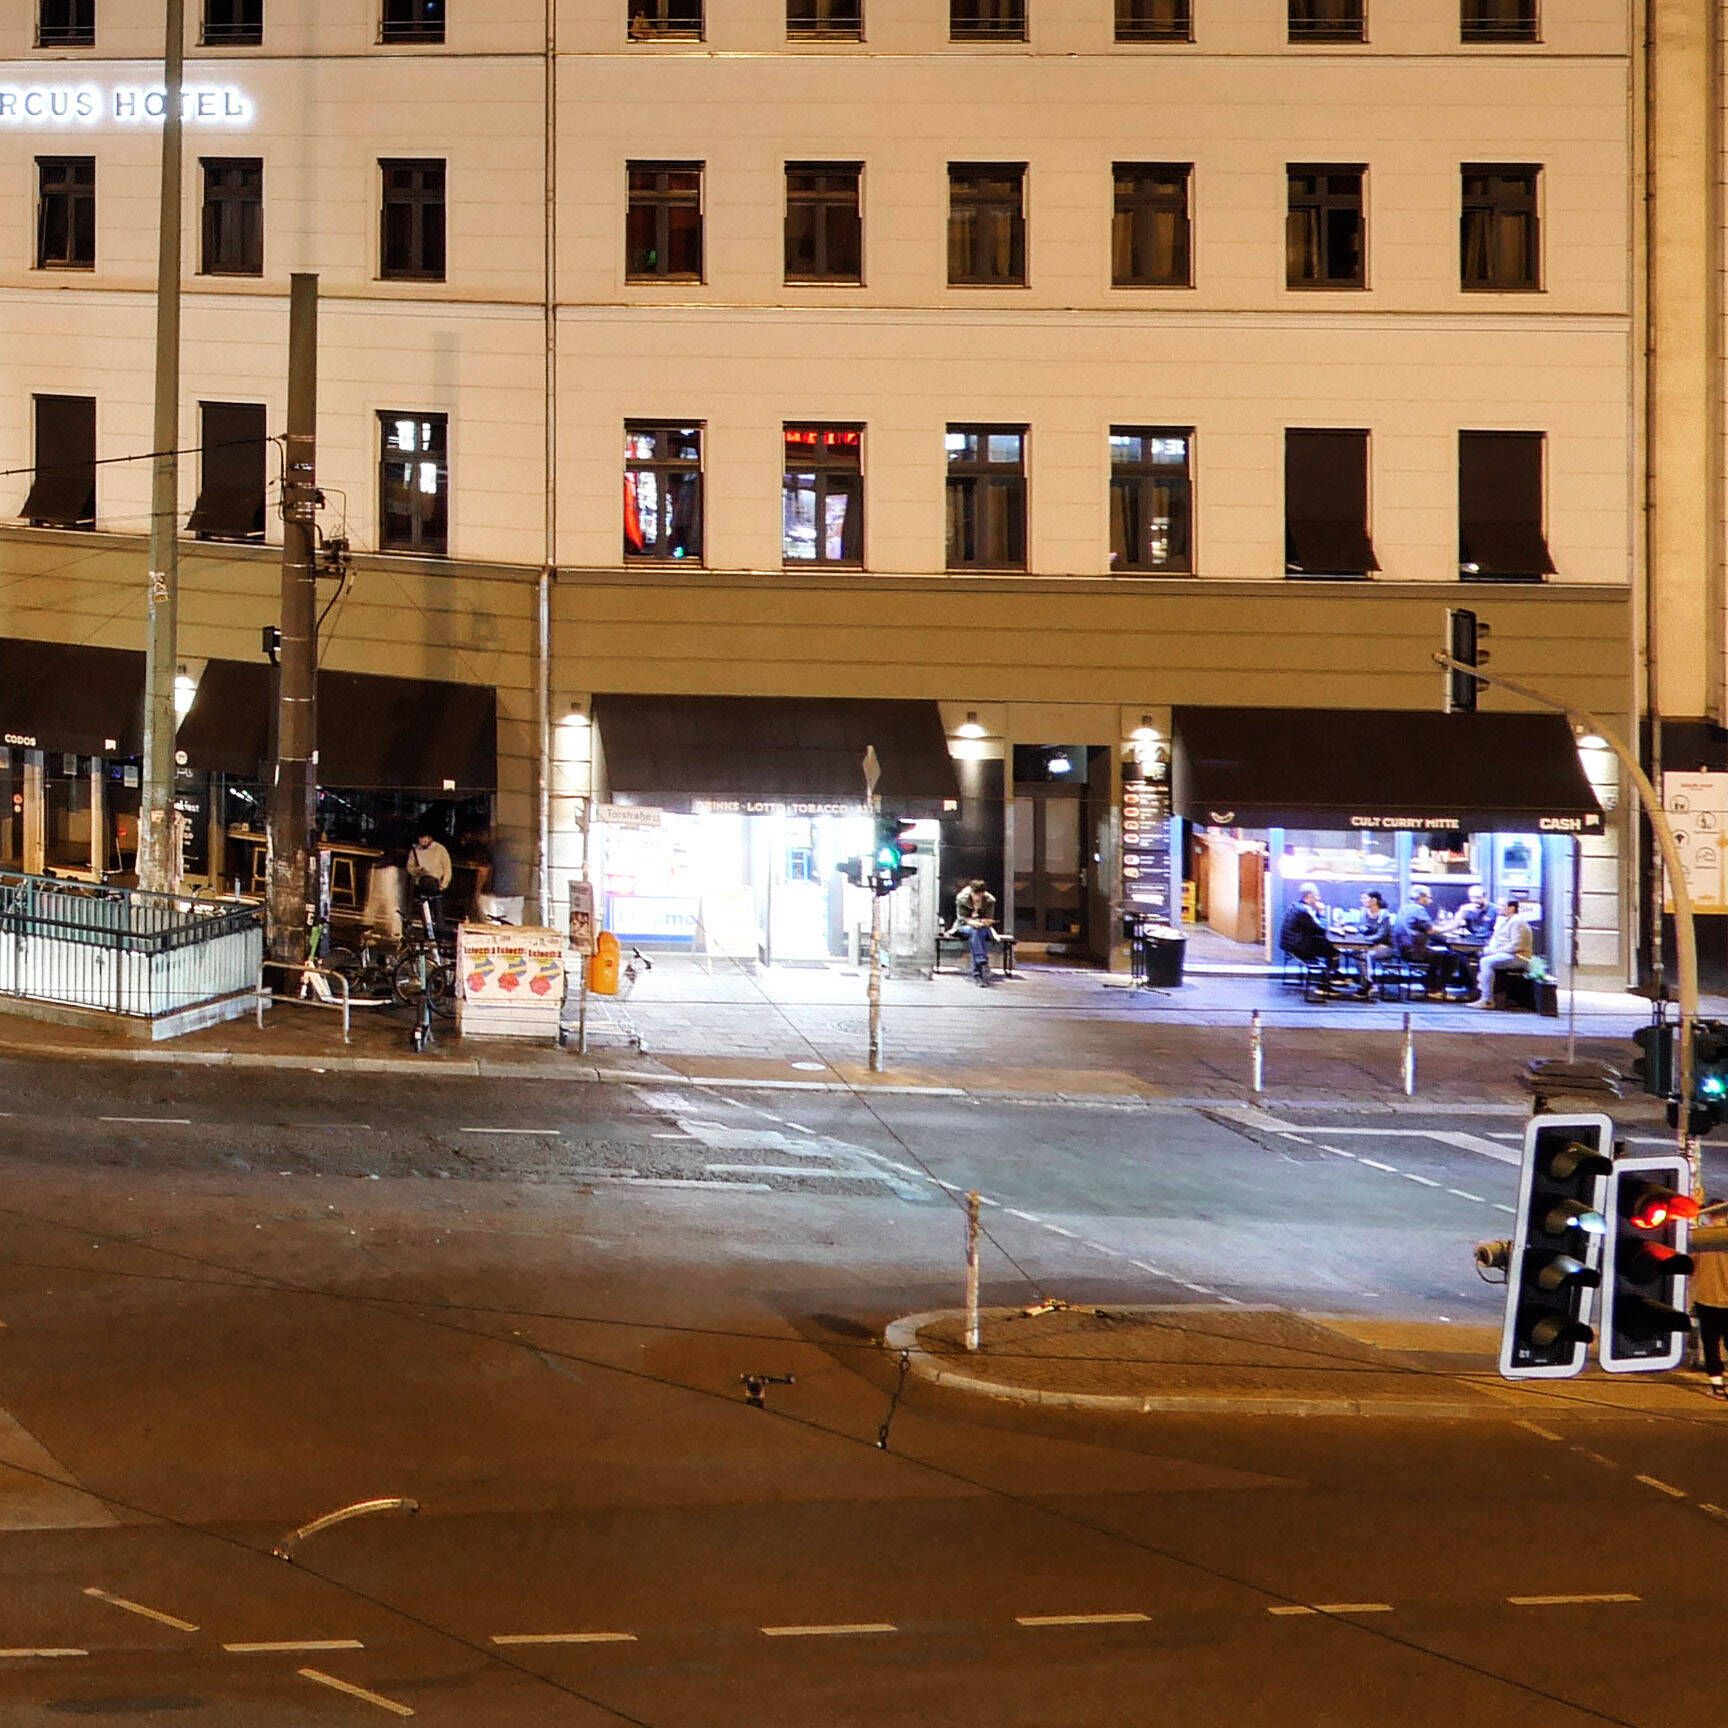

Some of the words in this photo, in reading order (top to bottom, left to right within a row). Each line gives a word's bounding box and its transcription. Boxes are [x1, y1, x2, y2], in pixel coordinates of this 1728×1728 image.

[4, 734, 37, 746] CODOS
[793, 803, 846, 814] TOBACCO
[1351, 816, 1381, 827] CULT
[1382, 817, 1424, 828] CURRY
[1425, 819, 1459, 829] MITTE
[1539, 818, 1582, 830] CASH
